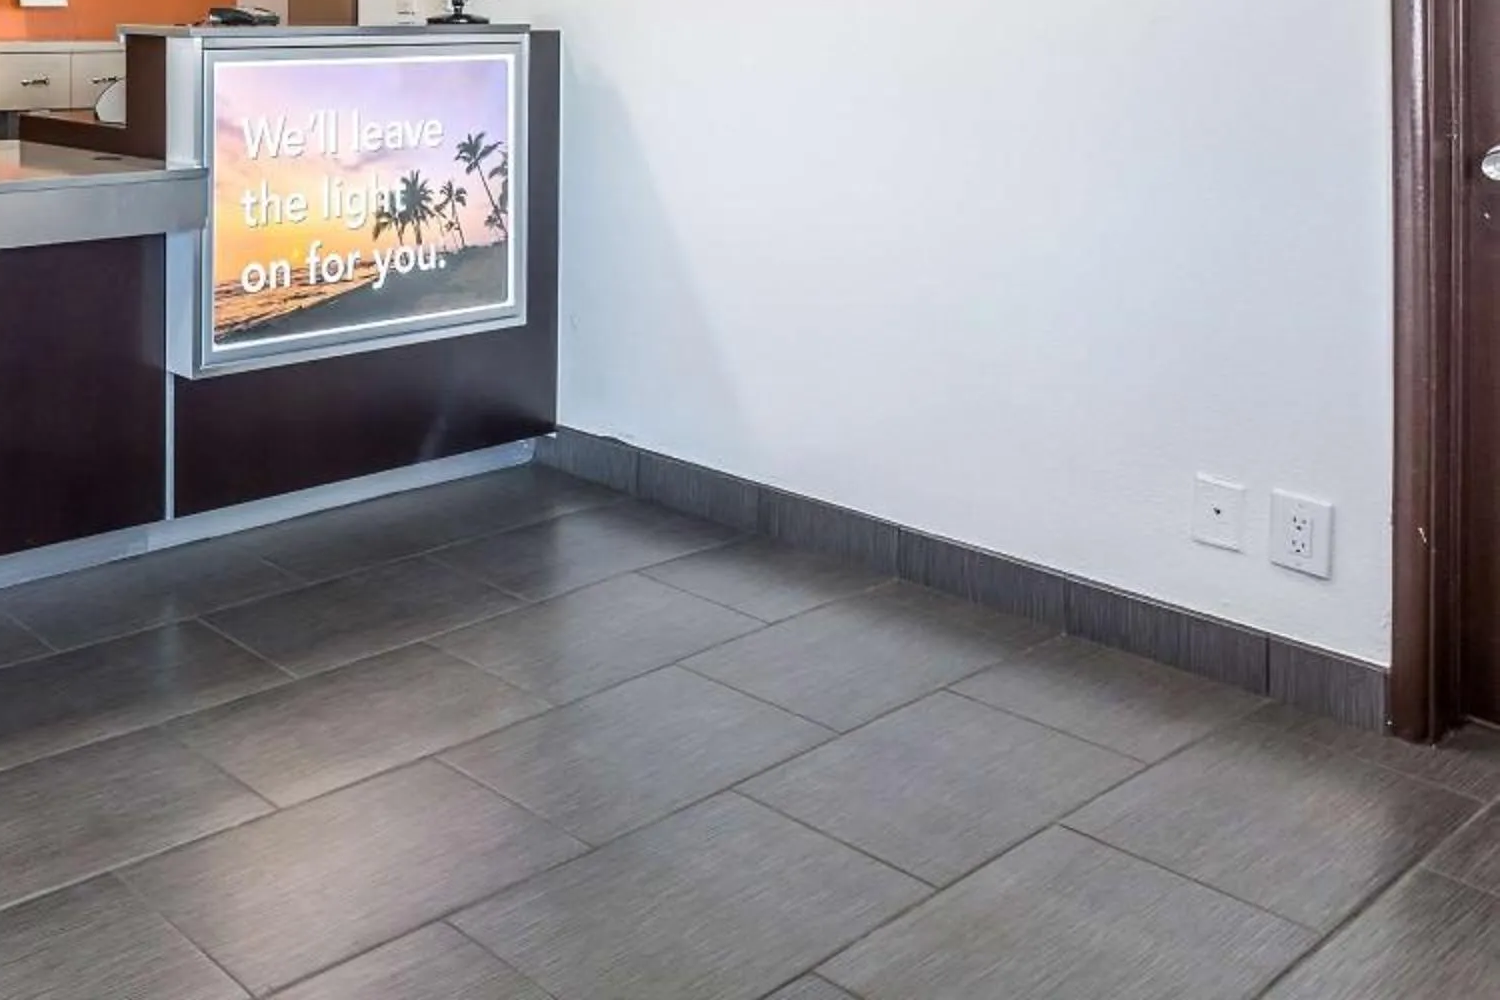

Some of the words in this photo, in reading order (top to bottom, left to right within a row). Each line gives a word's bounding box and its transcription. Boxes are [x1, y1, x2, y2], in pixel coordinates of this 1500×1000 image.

[241, 109, 338, 160] We'll
[352, 108, 444, 151] leave
[240, 179, 308, 228] the
[322, 173, 409, 230] light
[241, 260, 292, 293] on
[306, 239, 361, 285] for
[372, 243, 446, 289] you.
